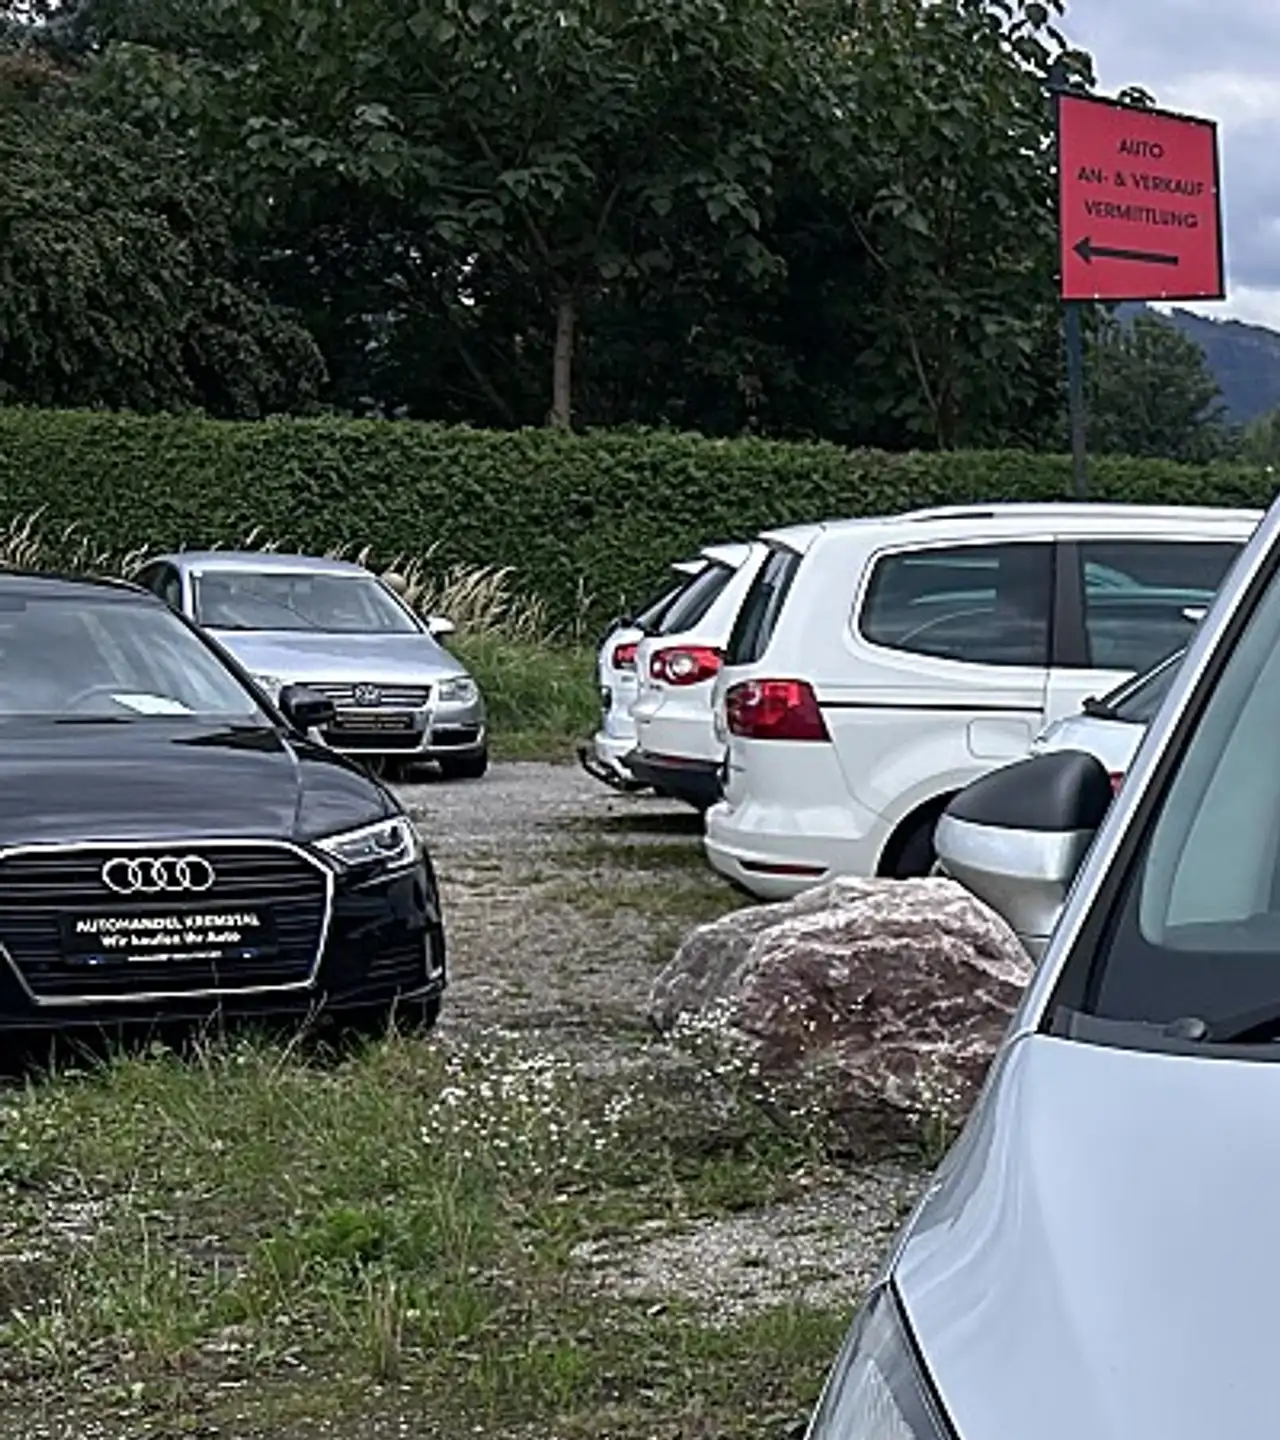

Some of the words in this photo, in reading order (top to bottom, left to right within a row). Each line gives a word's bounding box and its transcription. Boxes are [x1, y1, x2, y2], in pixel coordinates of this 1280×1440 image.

[1117, 138, 1165, 159] AUTO
[1077, 166, 1108, 185] AN-
[1113, 171, 1127, 189] &
[1130, 172, 1205, 197] VERKAUF
[1083, 200, 1200, 229] VERMITTLUNG
[75, 915, 183, 933] AUTOHANDEL
[184, 912, 261, 930] KREMSTAL
